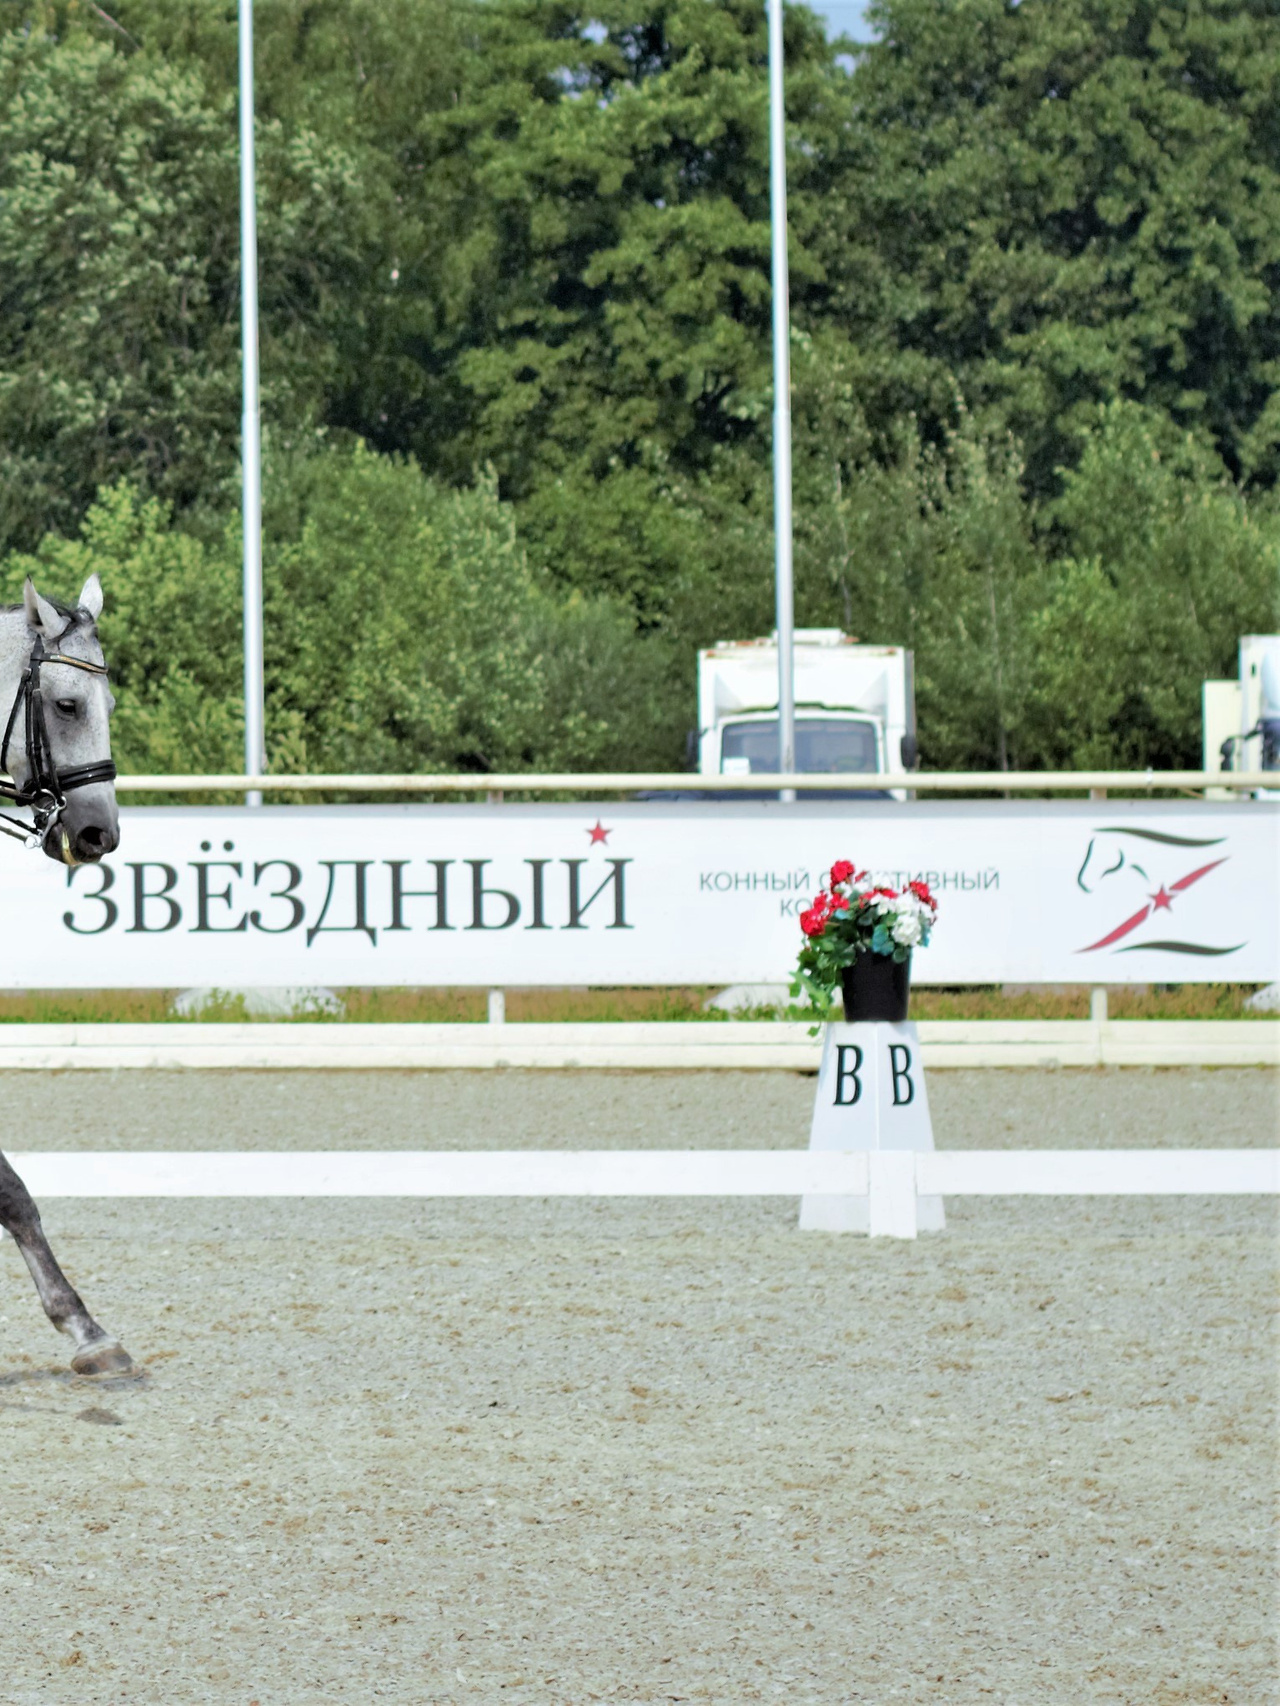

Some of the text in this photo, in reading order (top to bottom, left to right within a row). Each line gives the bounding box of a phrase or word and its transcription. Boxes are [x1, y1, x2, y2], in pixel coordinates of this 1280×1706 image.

[699, 867, 1001, 892] КОННЫЙ СТИВНЫЙ
[832, 1044, 864, 1106] B
[887, 1044, 915, 1107] B
